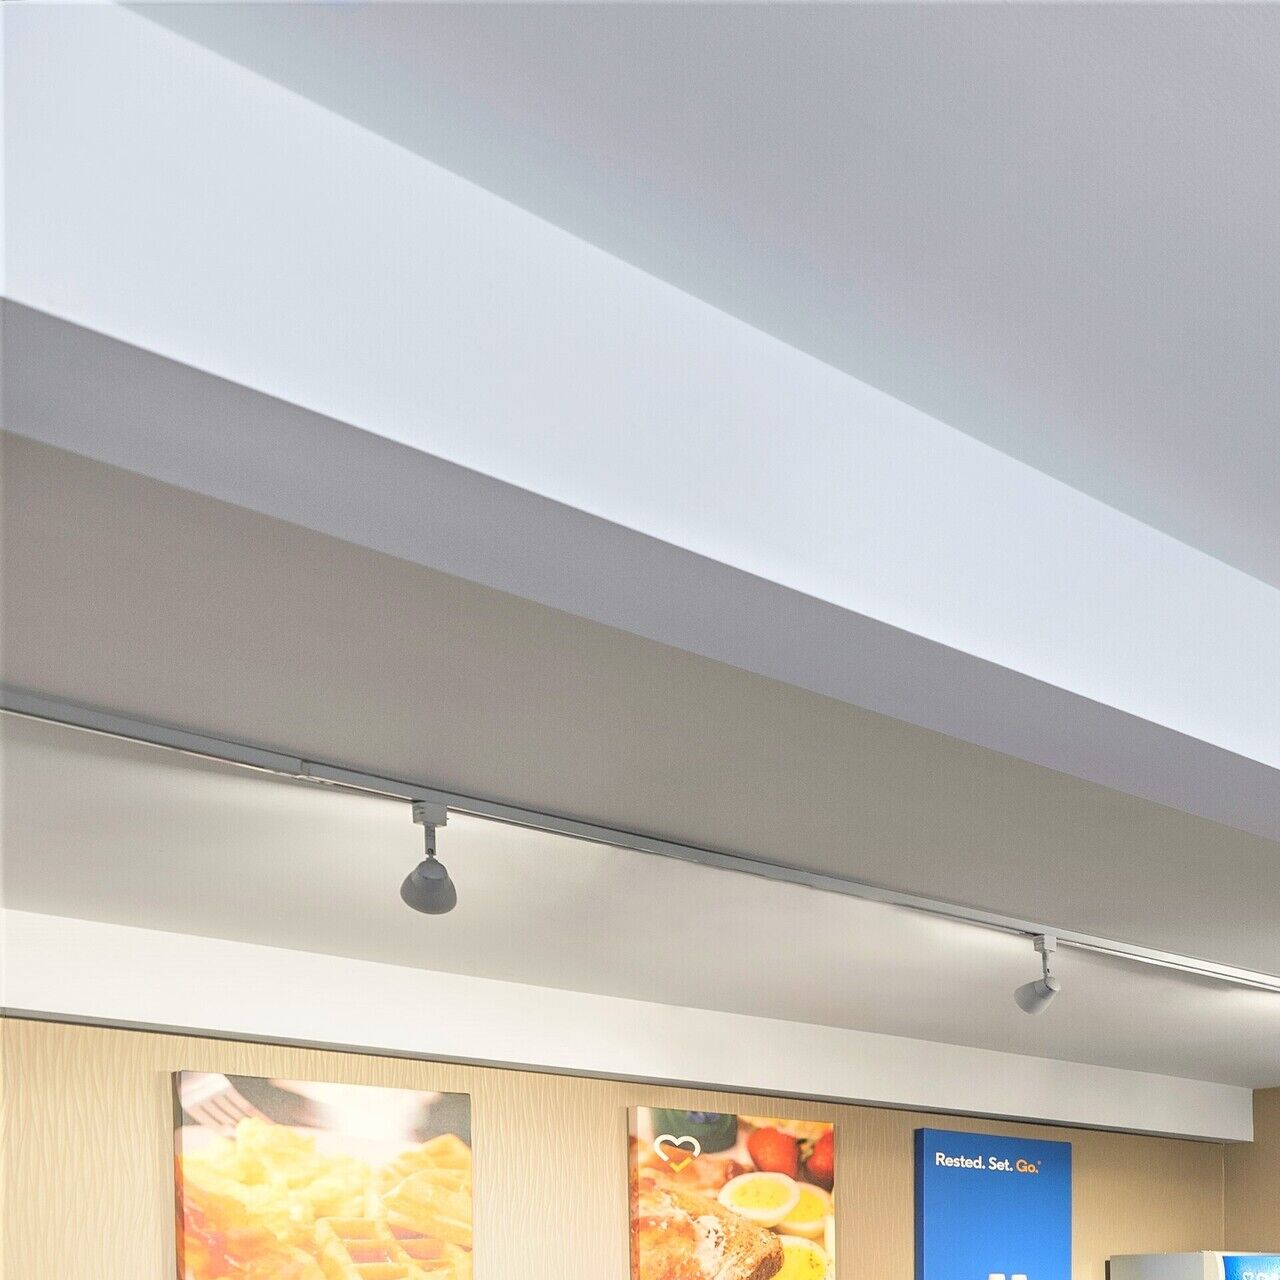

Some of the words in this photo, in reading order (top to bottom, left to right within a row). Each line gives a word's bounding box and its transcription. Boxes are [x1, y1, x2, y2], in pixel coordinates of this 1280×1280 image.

[935, 1152, 986, 1169] Rested.
[988, 1156, 1013, 1171] Set.
[1016, 1159, 1039, 1173] Go.
